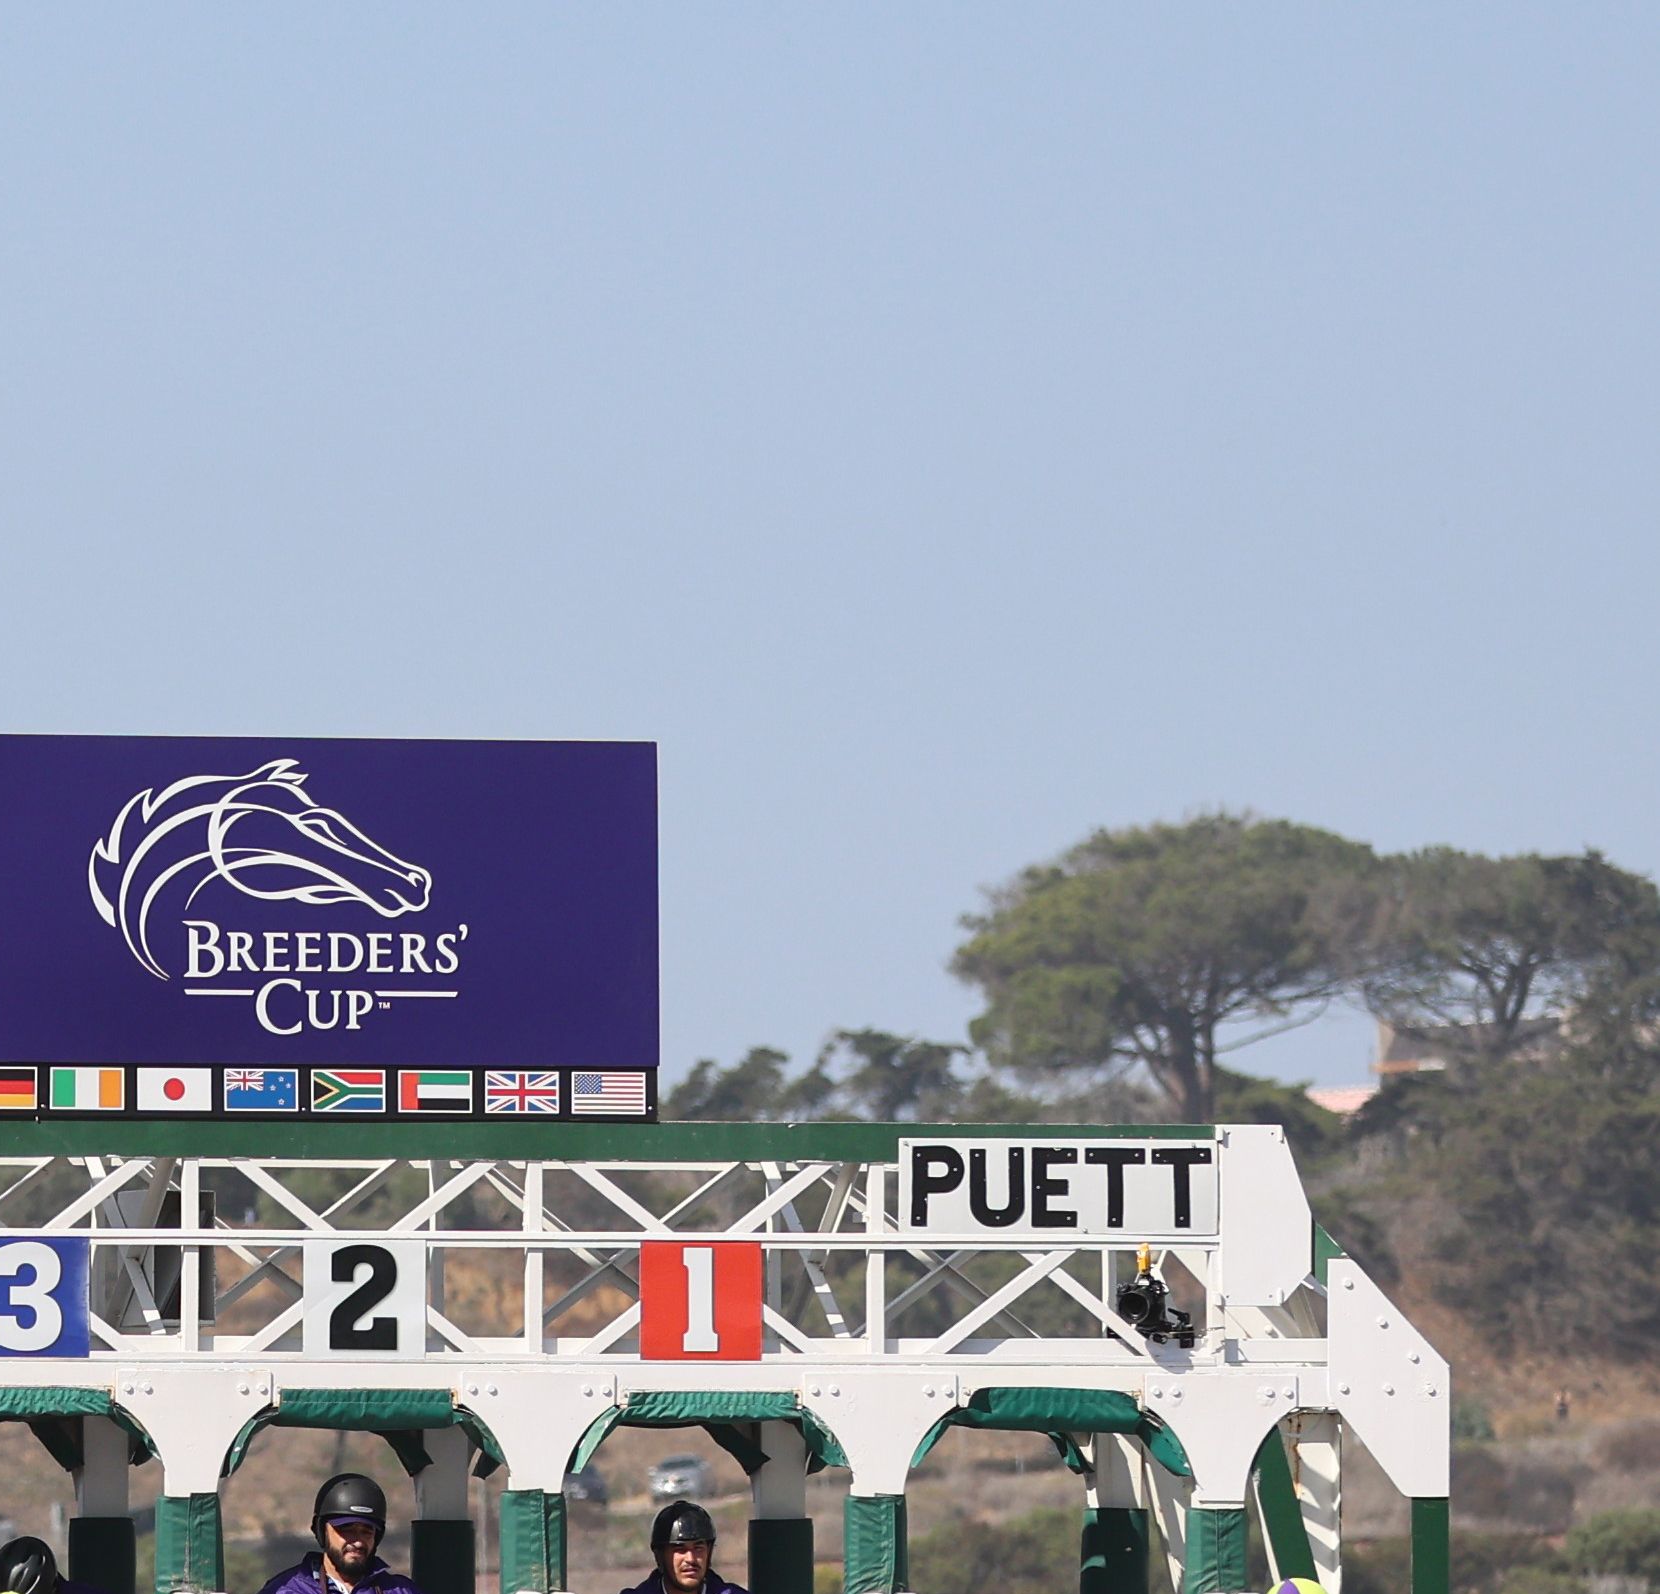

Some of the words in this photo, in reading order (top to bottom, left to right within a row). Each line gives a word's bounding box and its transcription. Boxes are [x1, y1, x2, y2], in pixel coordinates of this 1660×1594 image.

[910, 1145, 1212, 1228] PUETT
[329, 1244, 398, 1351] 2
[683, 1247, 719, 1352] 1
